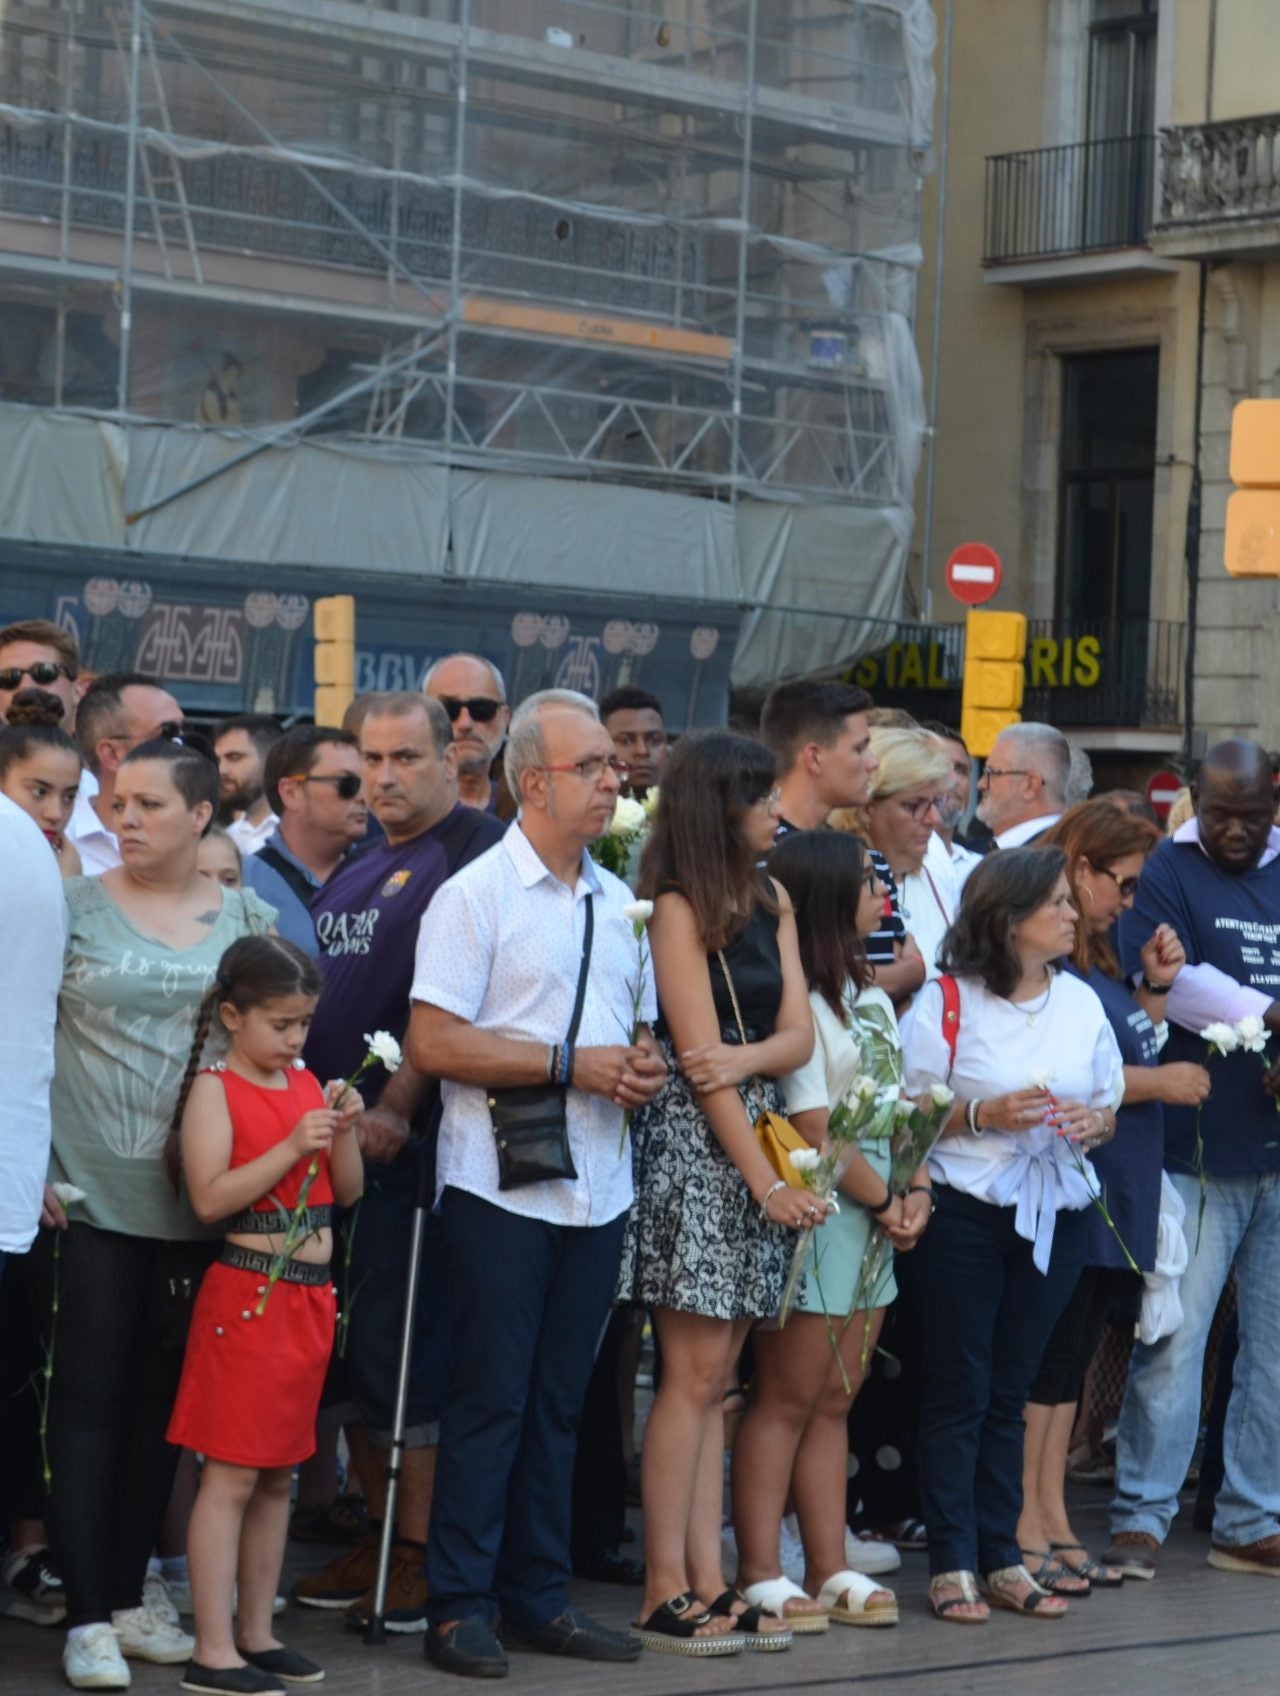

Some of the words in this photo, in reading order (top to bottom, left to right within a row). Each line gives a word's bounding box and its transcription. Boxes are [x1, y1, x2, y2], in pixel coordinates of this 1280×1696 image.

[356, 651, 432, 695] BBV
[838, 640, 949, 688] STAL
[1022, 635, 1101, 688] RIS
